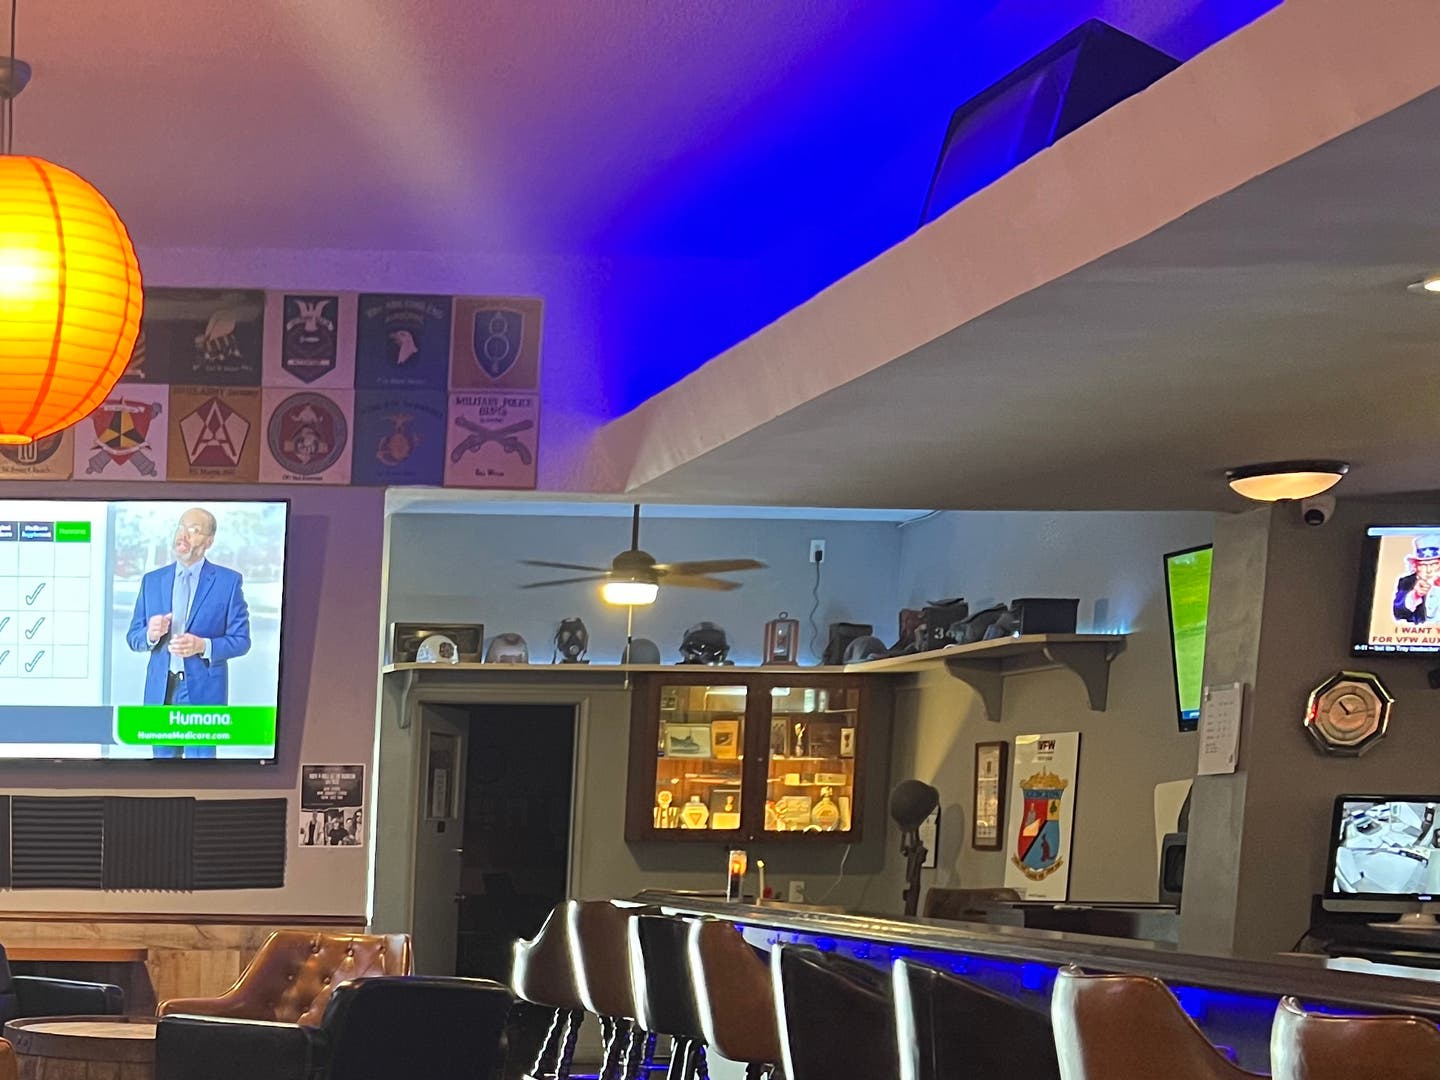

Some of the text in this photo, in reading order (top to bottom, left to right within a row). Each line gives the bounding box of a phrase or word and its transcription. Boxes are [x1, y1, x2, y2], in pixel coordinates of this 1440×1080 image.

[1401, 626, 1433, 635] WANT
[1396, 636, 1419, 644] VFW
[169, 710, 231, 726] Humana
[137, 731, 231, 741] HumanaMedicare.com
